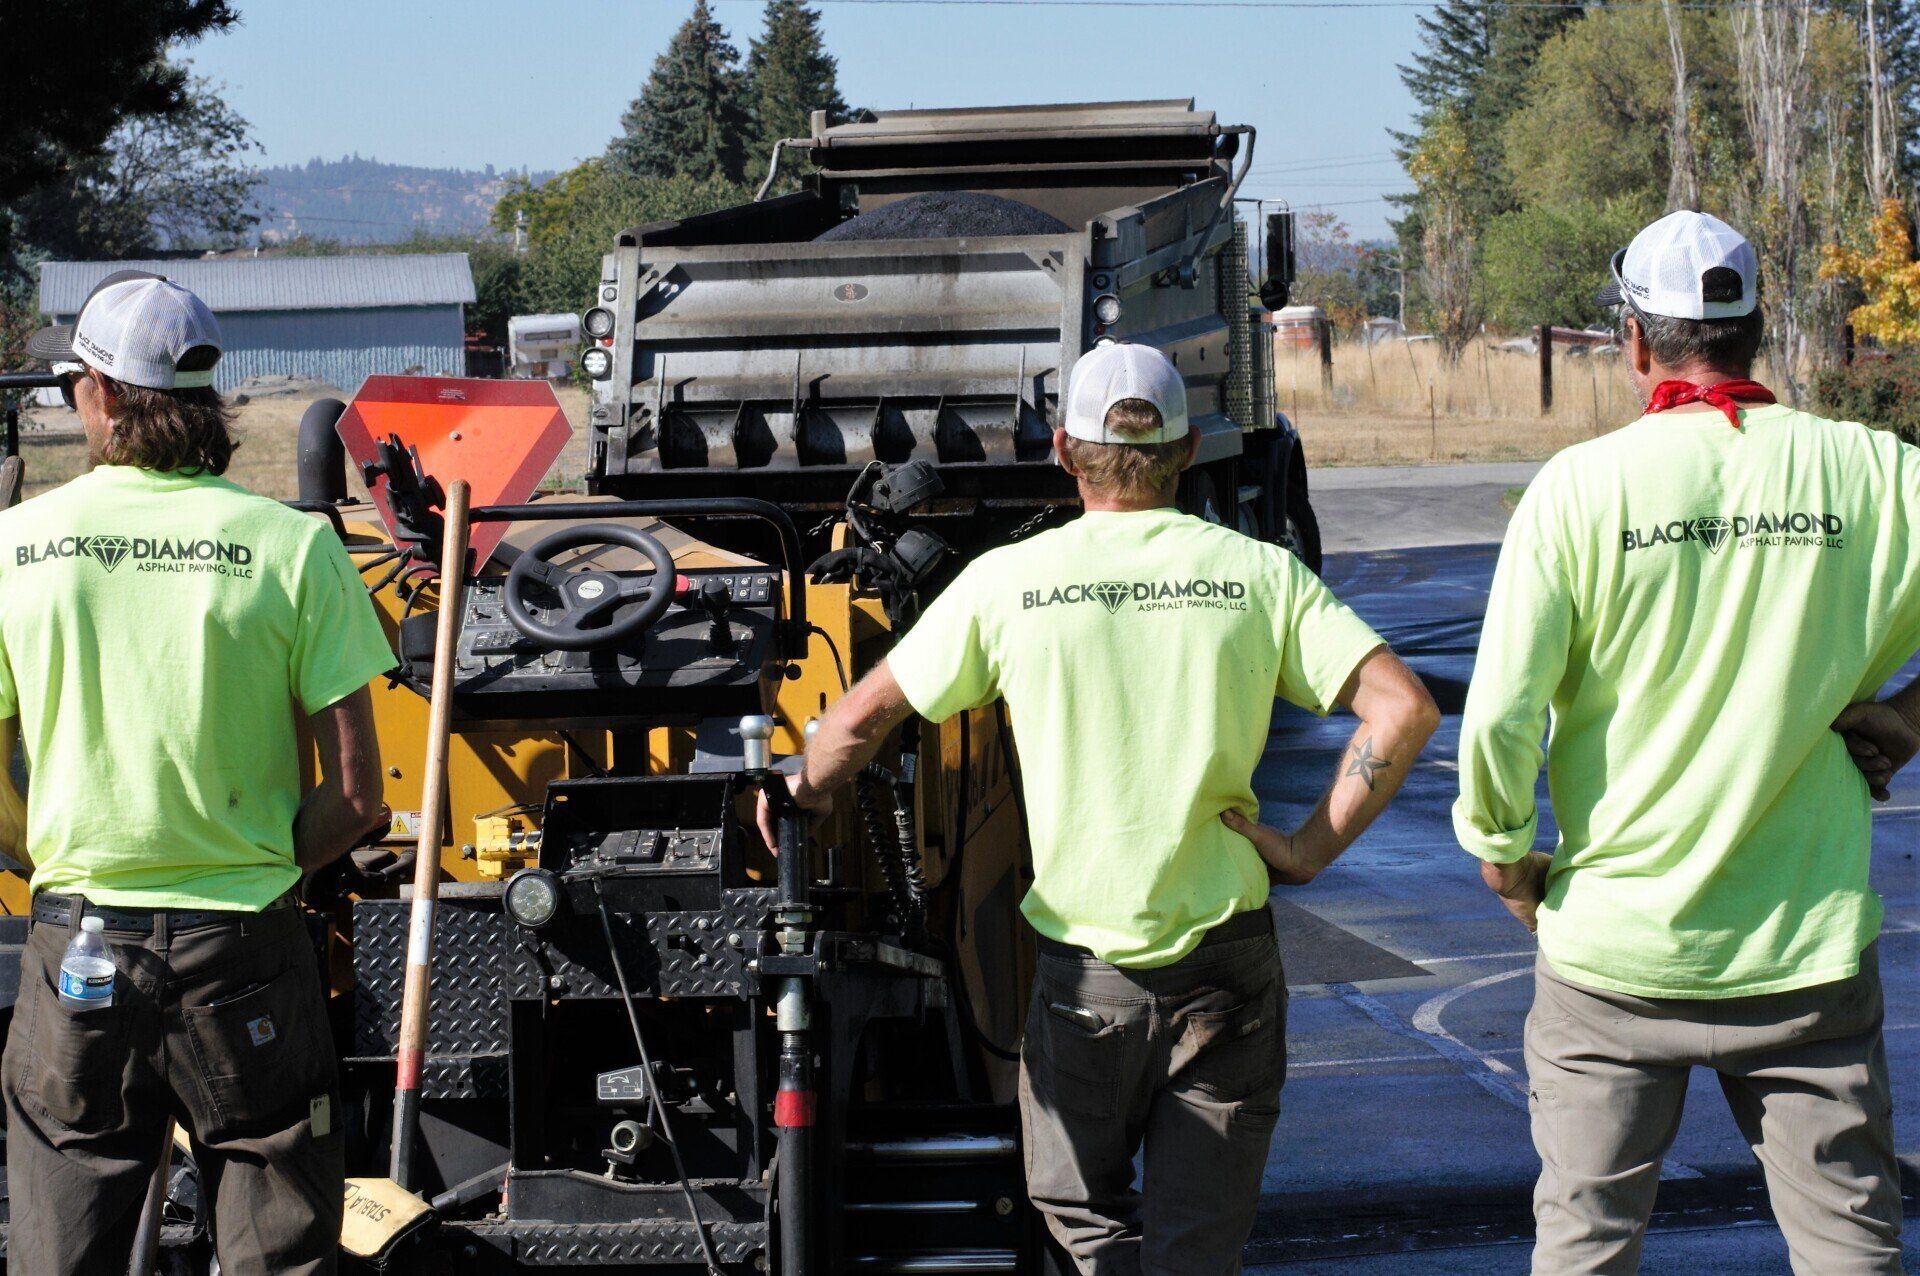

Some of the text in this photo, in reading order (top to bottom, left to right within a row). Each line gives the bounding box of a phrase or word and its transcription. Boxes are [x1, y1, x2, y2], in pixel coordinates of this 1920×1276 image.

[1621, 510, 1843, 553] BLACK DIAMOND
[1739, 536, 1782, 549] ASPHALT
[1826, 537, 1844, 549] LLC
[15, 536, 252, 567] BLACK DIAMOND
[136, 561, 253, 579] ASPHALT PAVING, LLC
[1022, 578, 1245, 610] BLACK DIAMOND
[1137, 599, 1247, 612] ASPHALT PAVING, LLC
